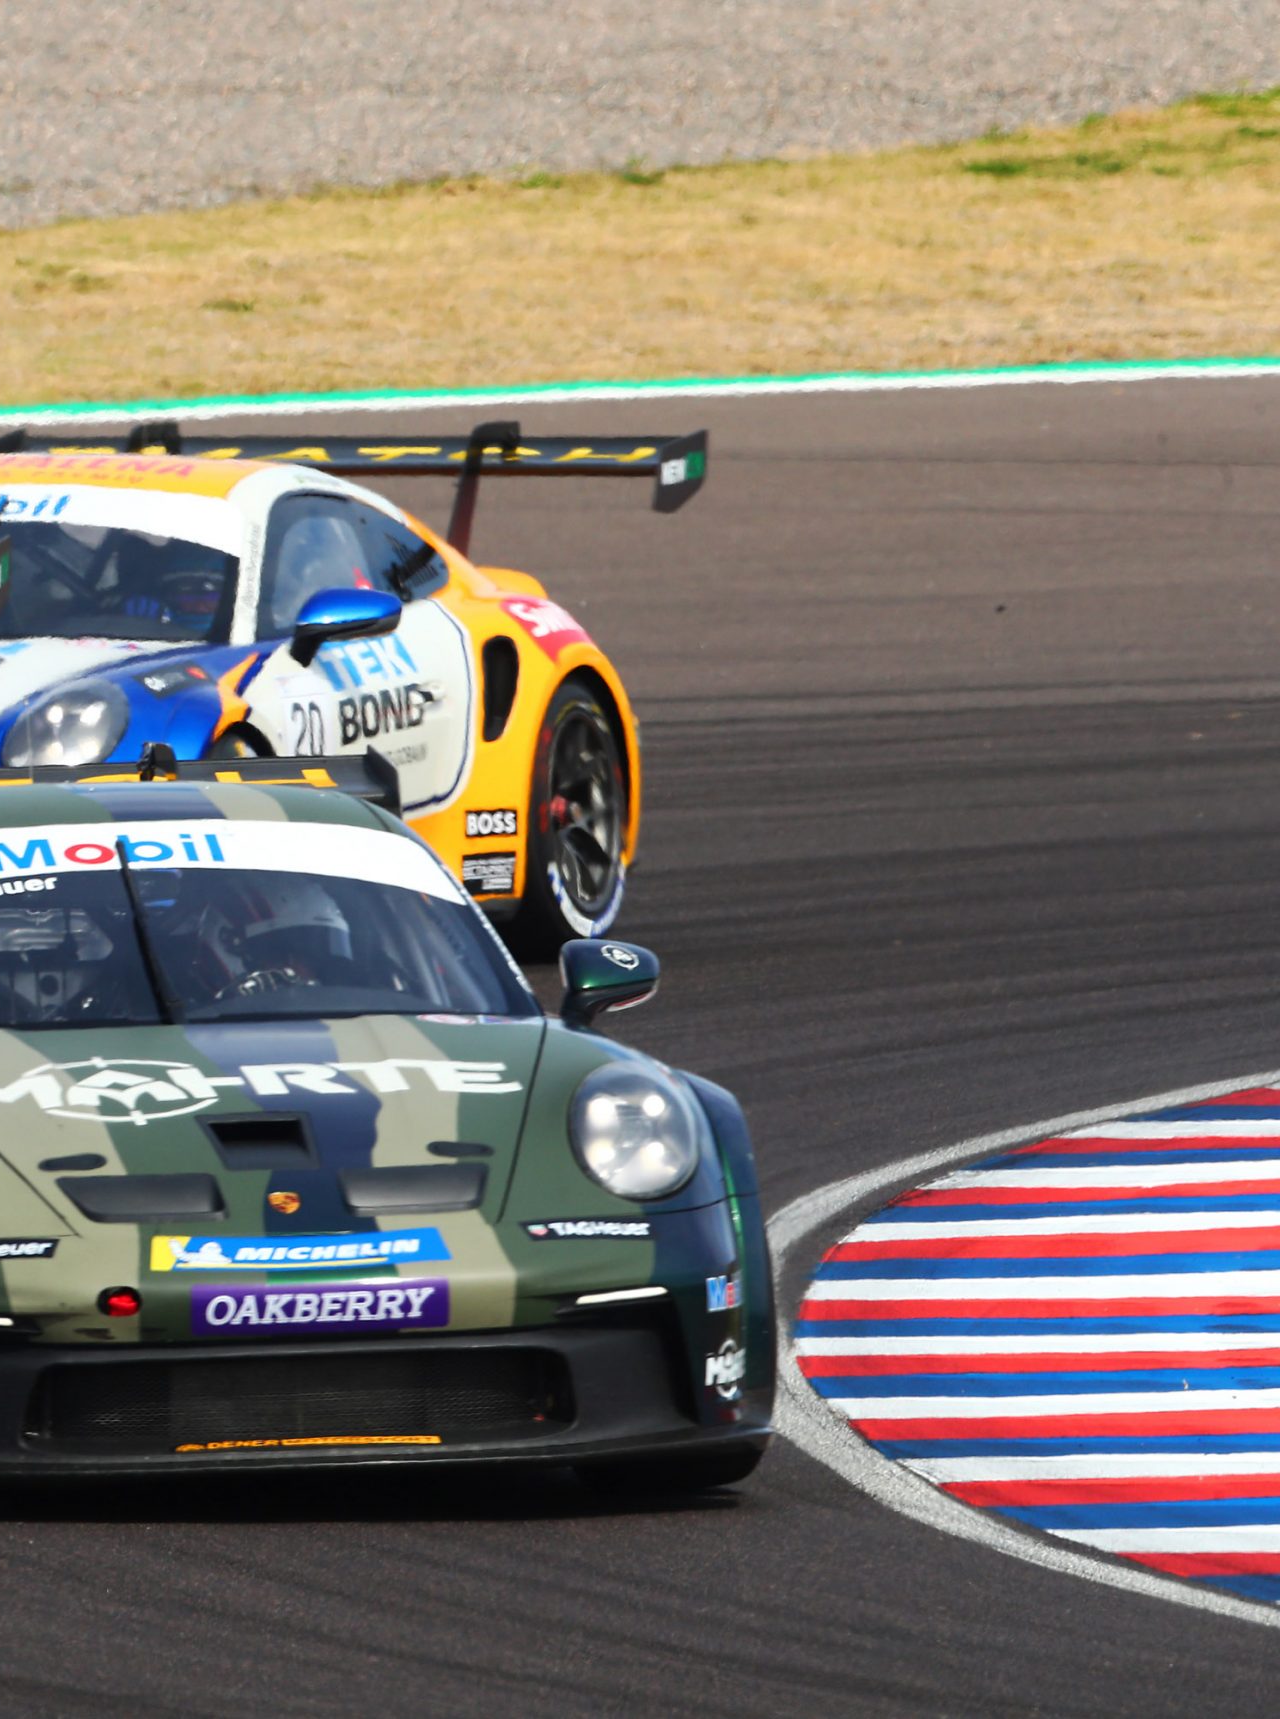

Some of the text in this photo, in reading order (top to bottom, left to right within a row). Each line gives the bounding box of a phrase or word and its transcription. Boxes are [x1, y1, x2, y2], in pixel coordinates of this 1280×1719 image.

[291, 701, 325, 756] 20
[338, 683, 425, 745] BOND
[466, 811, 516, 836] BOSS
[235, 1239, 420, 1262] MICHELIN
[205, 1286, 436, 1326] OAKBERRY
